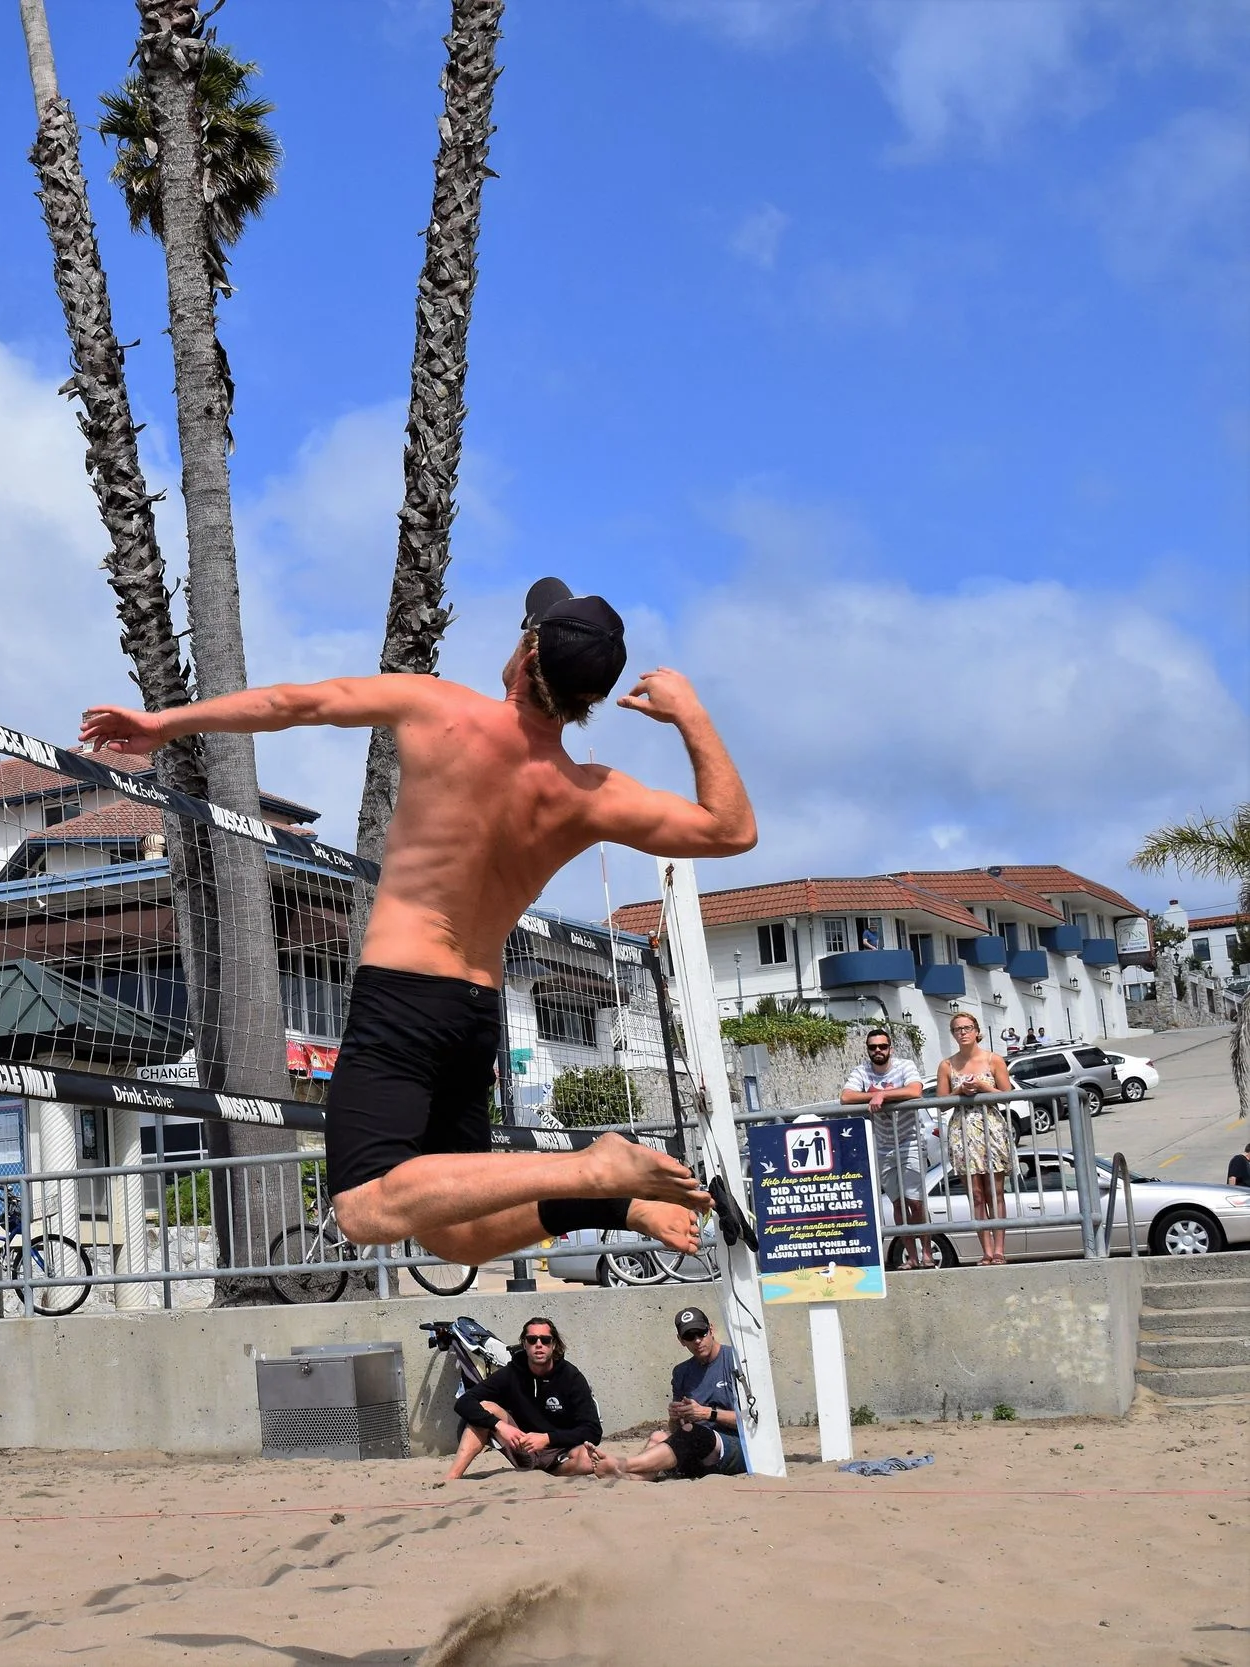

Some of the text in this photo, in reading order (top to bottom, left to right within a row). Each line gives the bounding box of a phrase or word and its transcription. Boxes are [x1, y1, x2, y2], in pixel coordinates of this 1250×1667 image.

[20, 734, 61, 770] MILK
[207, 802, 278, 845] MUSCLE MILK
[140, 1067, 197, 1080] CHANGE
[20, 1066, 57, 1099] MILK
[215, 1094, 285, 1126] MUSCLE MILK
[761, 1177, 780, 1187] Help
[812, 1173, 841, 1182] beaches
[770, 1182, 852, 1196] DID YOU PLACE
[770, 1191, 854, 1206] YOUR LITTER IN
[767, 1200, 863, 1215] THE TRASH CANS?
[819, 1240, 847, 1249] PONER
[767, 1251, 799, 1260] BASURA
[825, 1246, 872, 1256] BASURERO?
